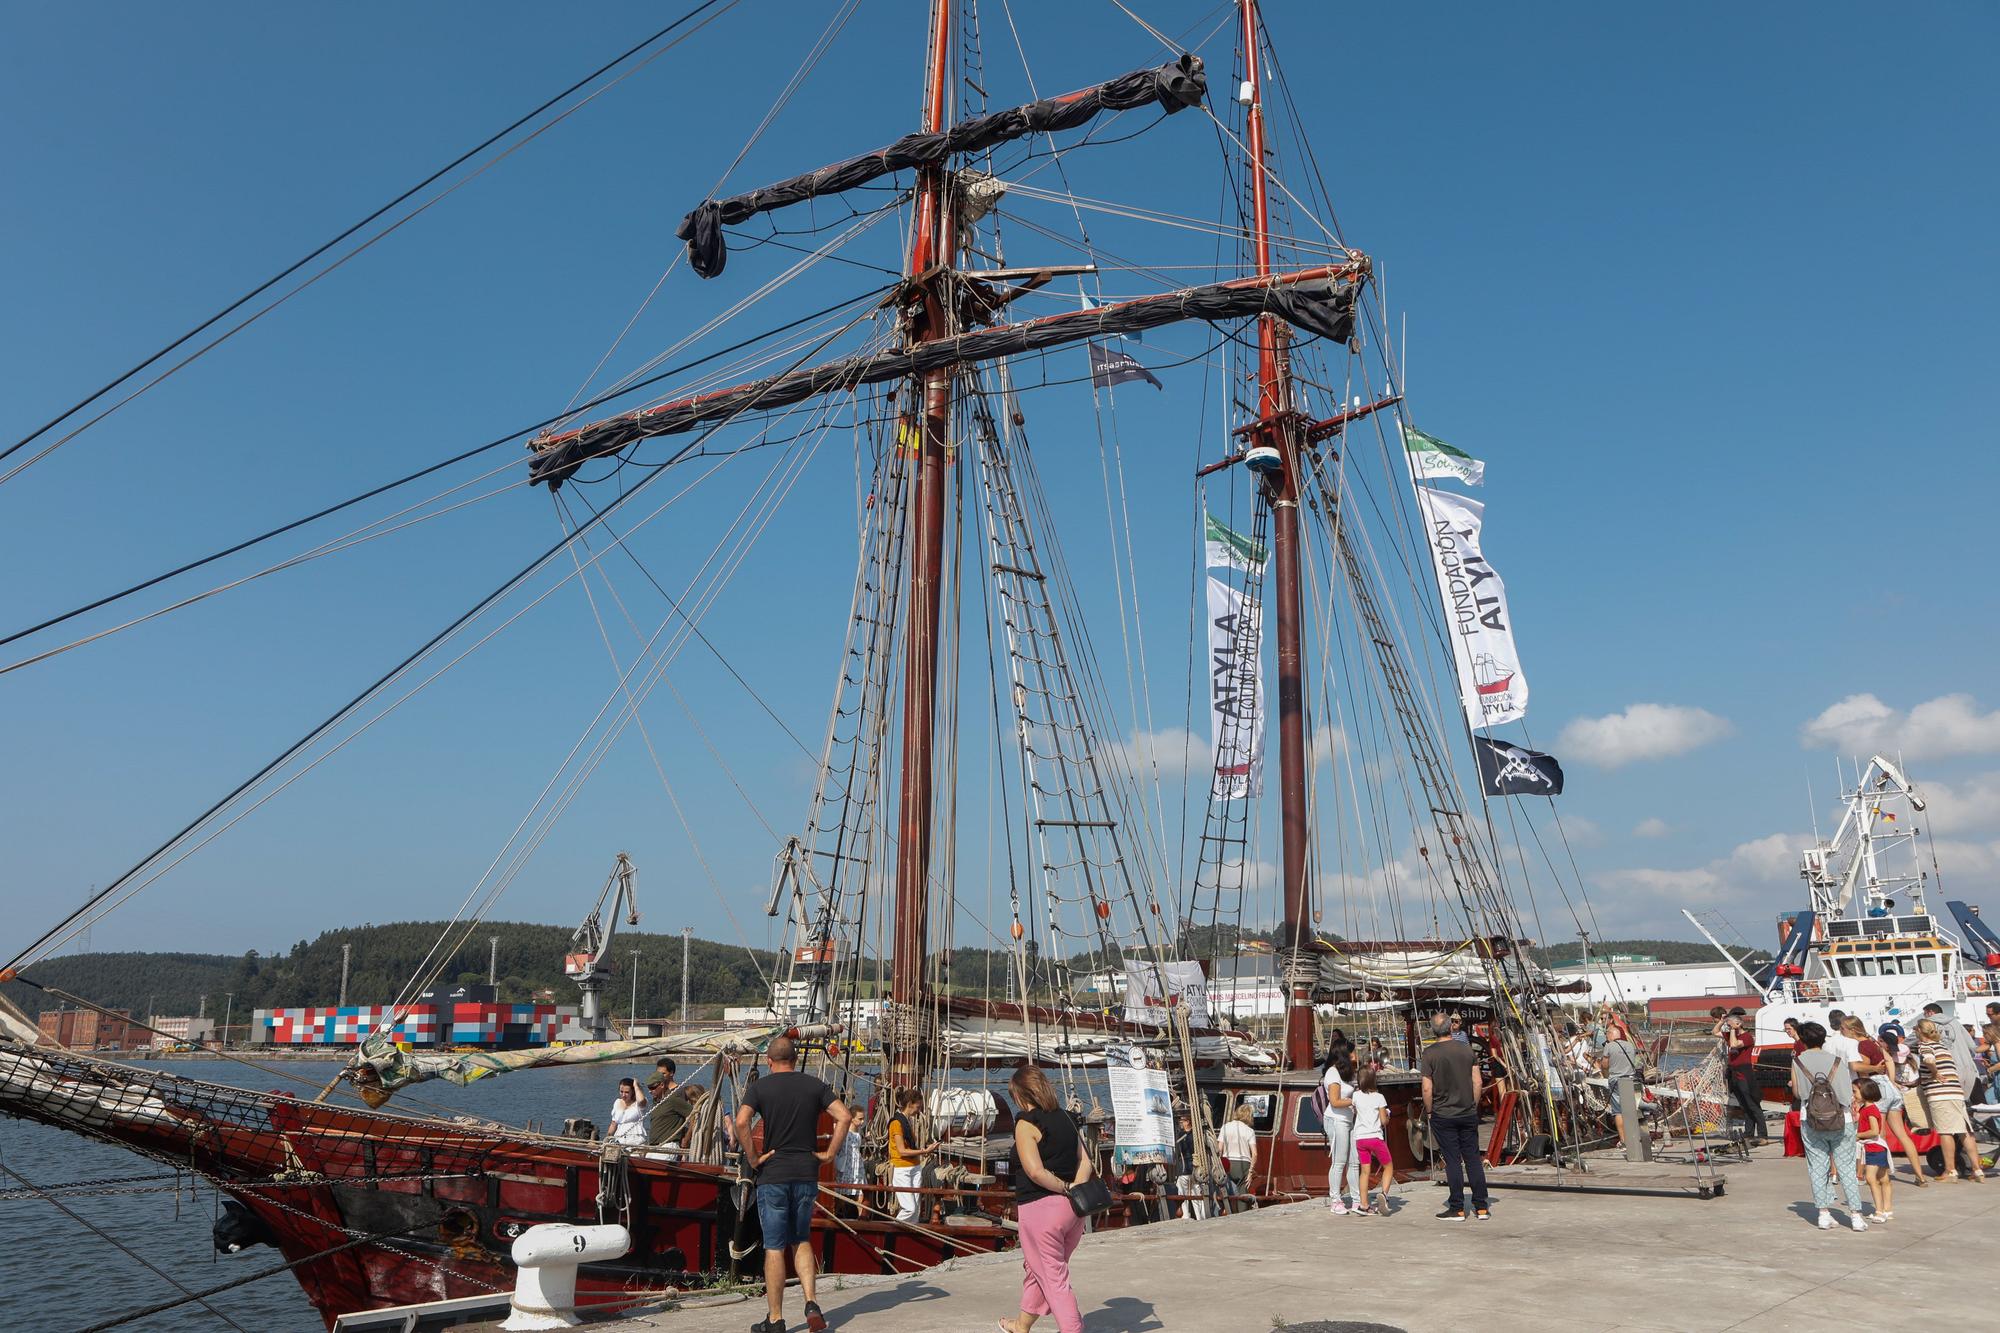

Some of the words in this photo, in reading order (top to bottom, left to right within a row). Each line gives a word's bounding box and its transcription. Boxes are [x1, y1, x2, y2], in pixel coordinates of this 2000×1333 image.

[1433, 520, 1480, 636] FUNDACIÓN
[1213, 613, 1238, 719] ATYLA
[1482, 702, 1515, 715] ATYLA
[1258, 991, 1282, 999] FRANCO
[573, 1234, 586, 1253] 9
